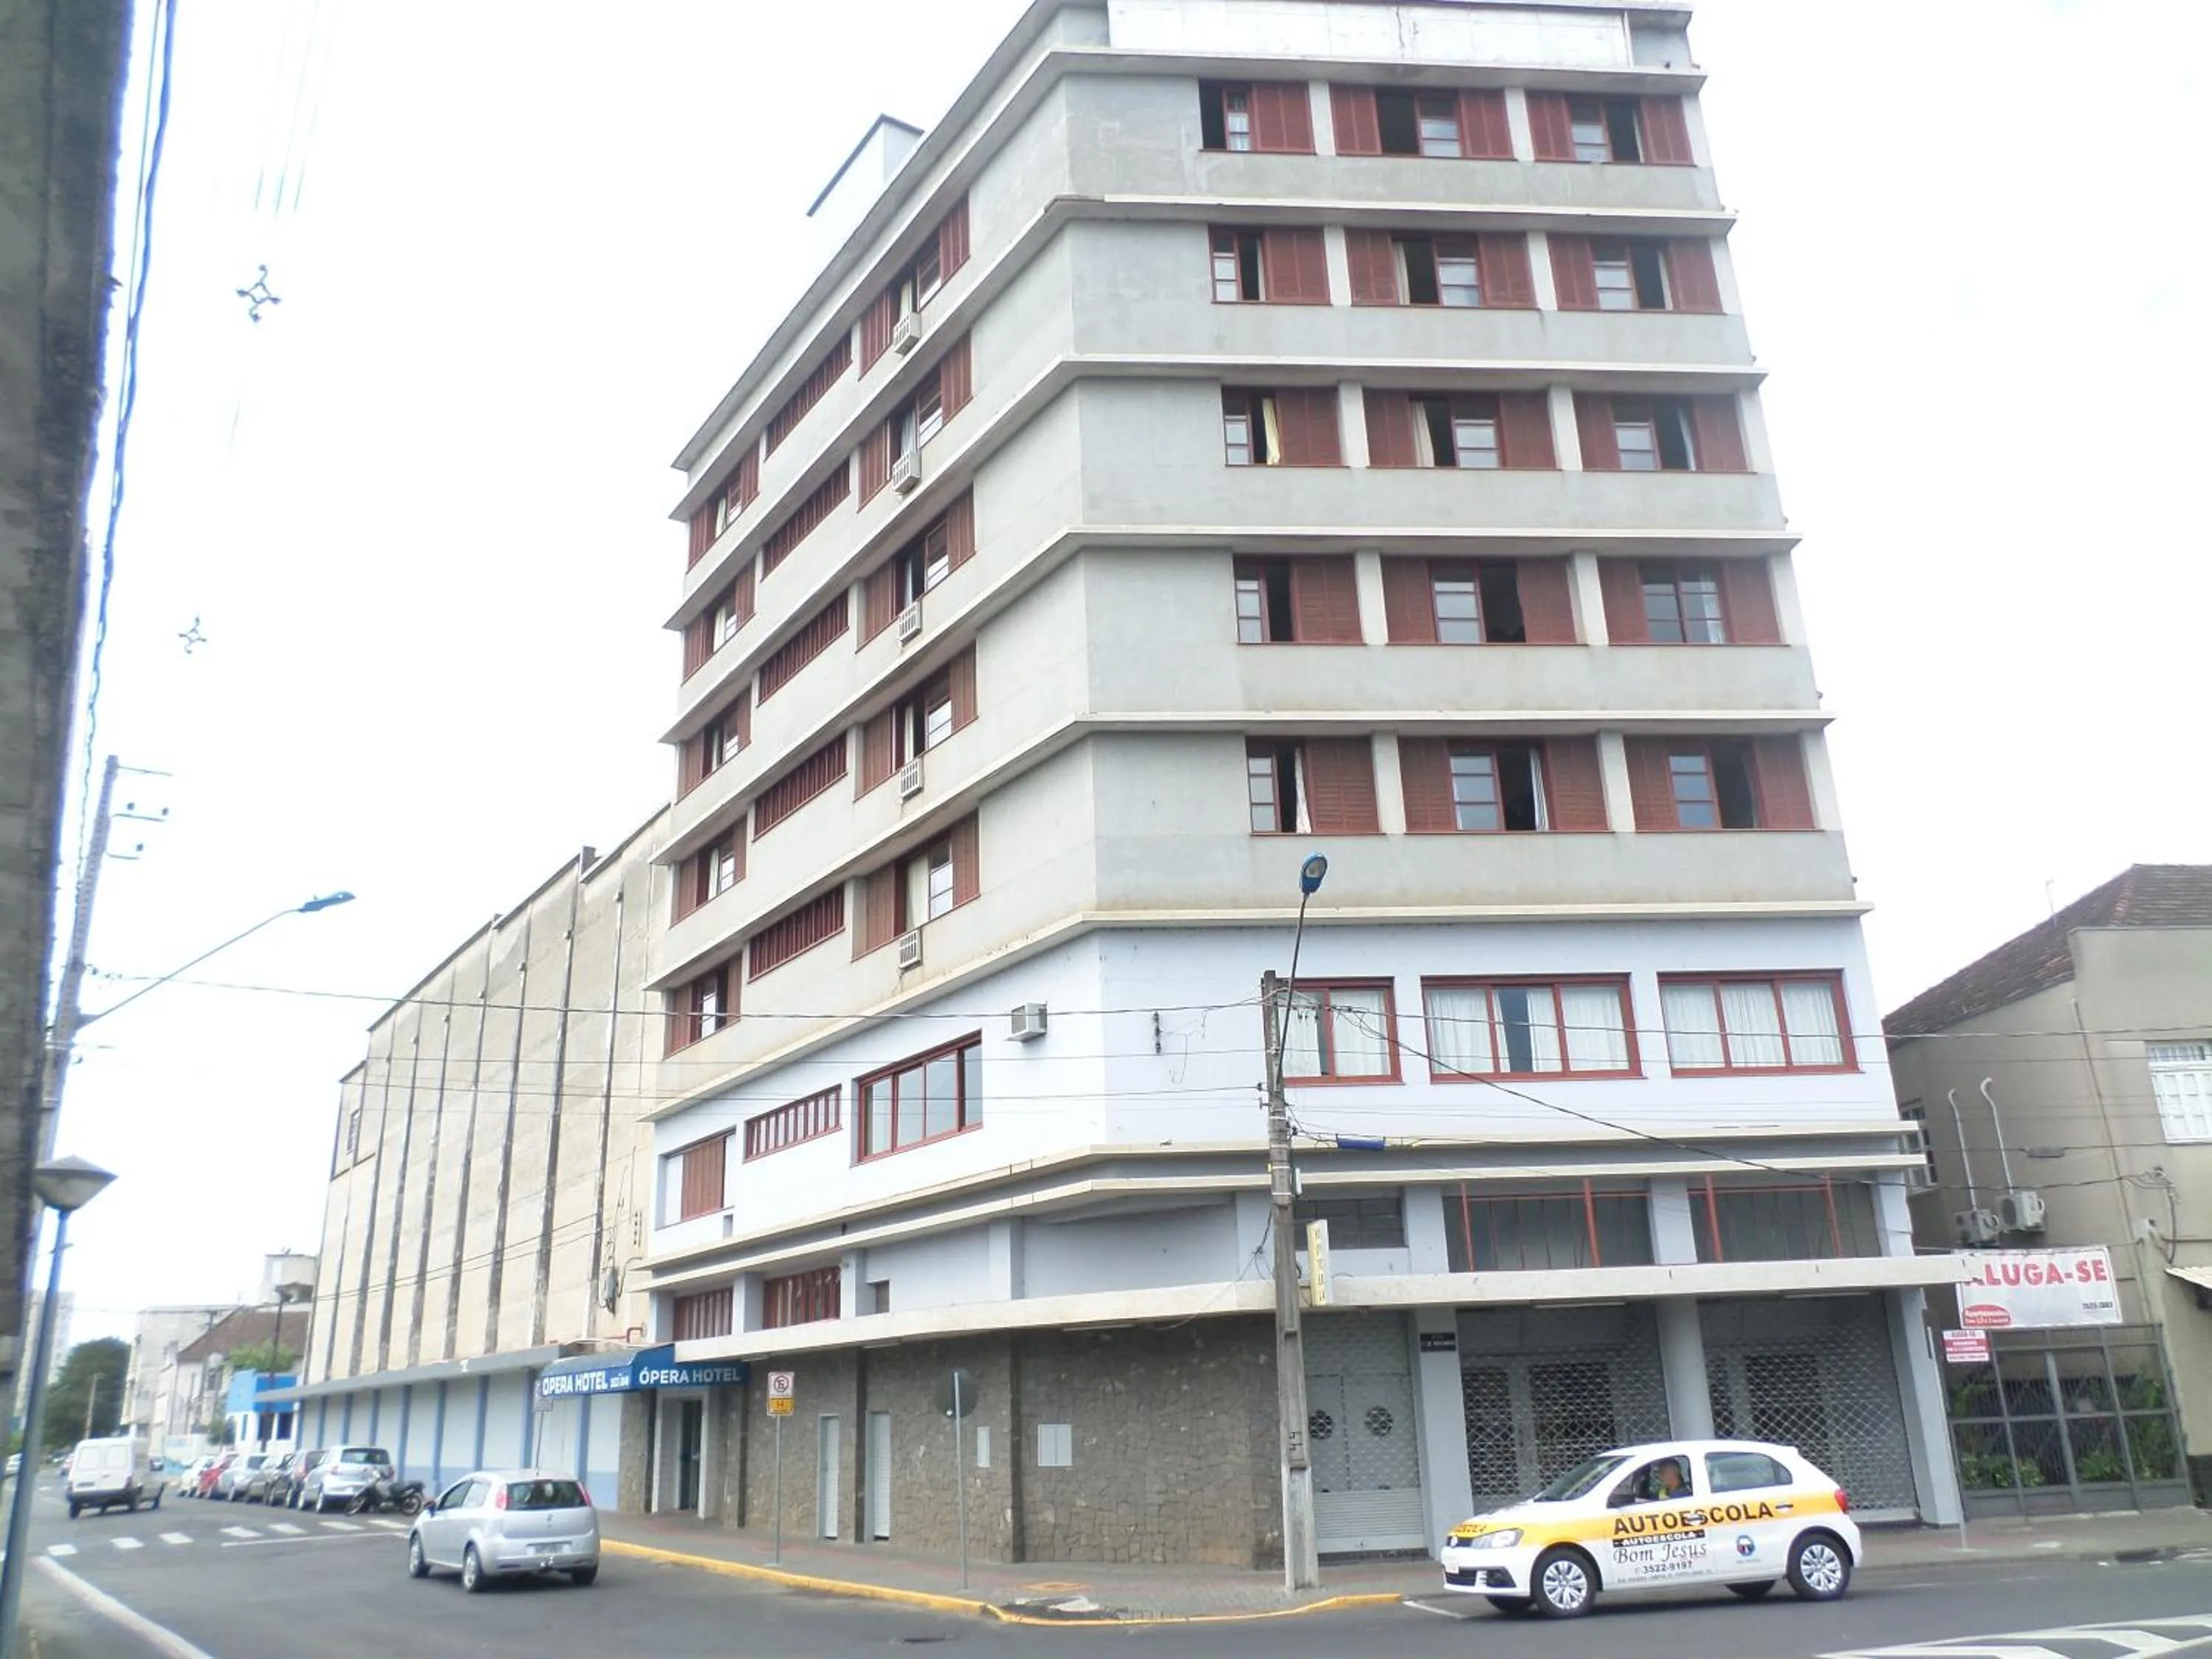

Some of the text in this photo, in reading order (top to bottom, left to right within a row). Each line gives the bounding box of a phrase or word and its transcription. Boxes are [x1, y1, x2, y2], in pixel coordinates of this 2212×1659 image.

[575, 1371, 608, 1391] HOTEL
[639, 1366, 689, 1385] ÓPERA
[692, 1368, 740, 1382] HOTEL
[1613, 1502, 1774, 1535] AUTOESCOLA
[1622, 1531, 1696, 1546] AUTOESCOLA
[1613, 1543, 1707, 1564] Bom Jesus
